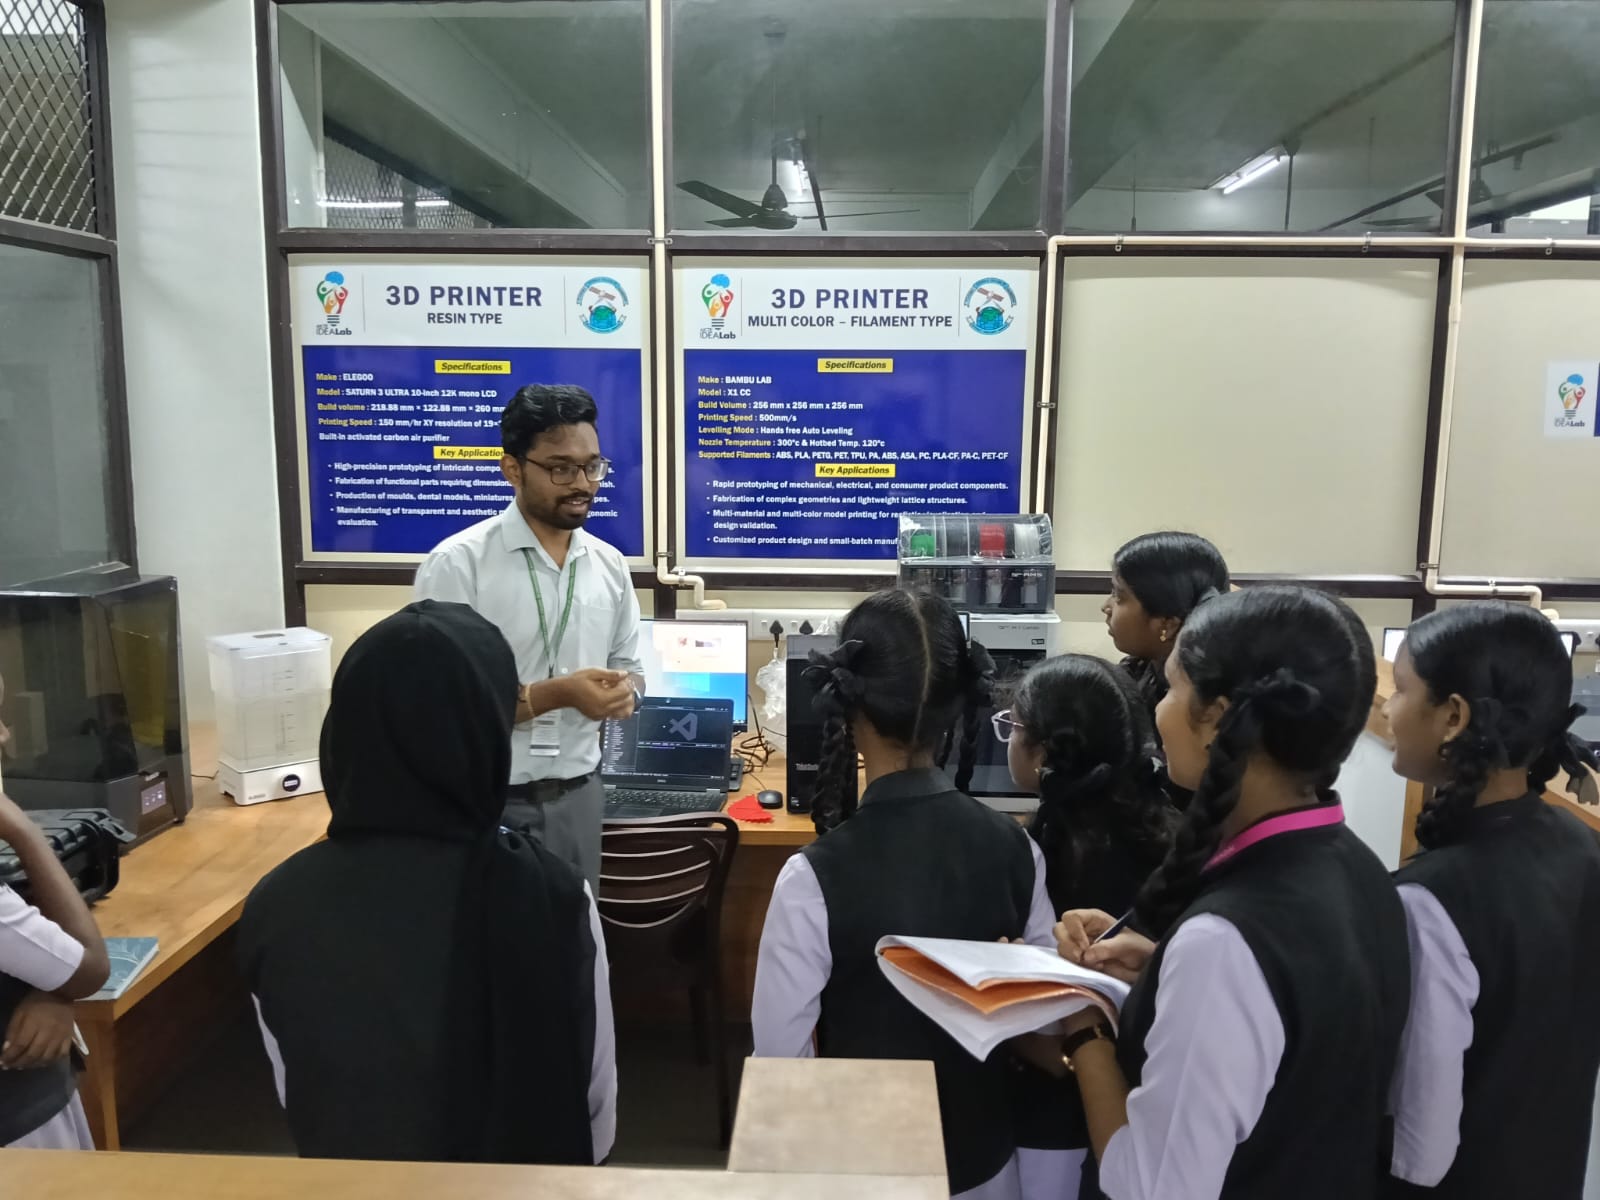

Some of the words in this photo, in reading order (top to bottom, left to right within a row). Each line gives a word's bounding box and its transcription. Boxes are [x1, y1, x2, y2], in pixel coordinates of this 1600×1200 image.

[385, 285, 420, 306] 3D
[430, 286, 542, 306] PRINTER
[771, 288, 805, 309] 3D
[816, 288, 928, 309] PRINTER
[428, 312, 466, 324] RESIN
[470, 313, 502, 324] TYPE
[748, 316, 786, 327] MULTI
[791, 316, 834, 327] COLOR
[851, 316, 916, 327] FILAMENT
[920, 316, 952, 327] TYPE
[440, 362, 504, 372] Specifications
[824, 361, 887, 370] Specifications
[318, 418, 348, 427] Printing
[349, 418, 373, 426] Speed
[434, 419, 473, 427] resolution
[698, 414, 728, 422] Printing
[730, 414, 753, 422] Speed
[822, 427, 853, 436] Leveling
[422, 434, 450, 442] purifier
[724, 438, 772, 447] Temperature
[838, 440, 860, 448] Temp.
[440, 448, 455, 459] Key
[458, 447, 504, 459] Application
[698, 450, 735, 459] Supported
[389, 464, 432, 472] prototyping
[442, 464, 474, 472] intricate
[820, 466, 834, 475] Key
[837, 466, 889, 475] Applications
[420, 479, 439, 487] parts
[440, 478, 472, 488] requiring
[712, 480, 735, 489] Rapid
[736, 481, 779, 489] prototyping
[789, 481, 834, 489] mechanical,
[929, 482, 958, 490] product
[960, 482, 1008, 490] components.
[712, 494, 755, 503] Fabrication
[766, 496, 797, 504] complex
[798, 495, 840, 505] geometries
[858, 496, 900, 505] lightweight
[337, 506, 391, 516] Manufacturing
[402, 508, 445, 516] transparent
[712, 509, 765, 517] Multi-material
[848, 511, 878, 520] printing
[337, 518, 379, 526] evaluation.
[714, 522, 738, 530] design
[758, 537, 786, 545] product
[787, 537, 812, 546] design
